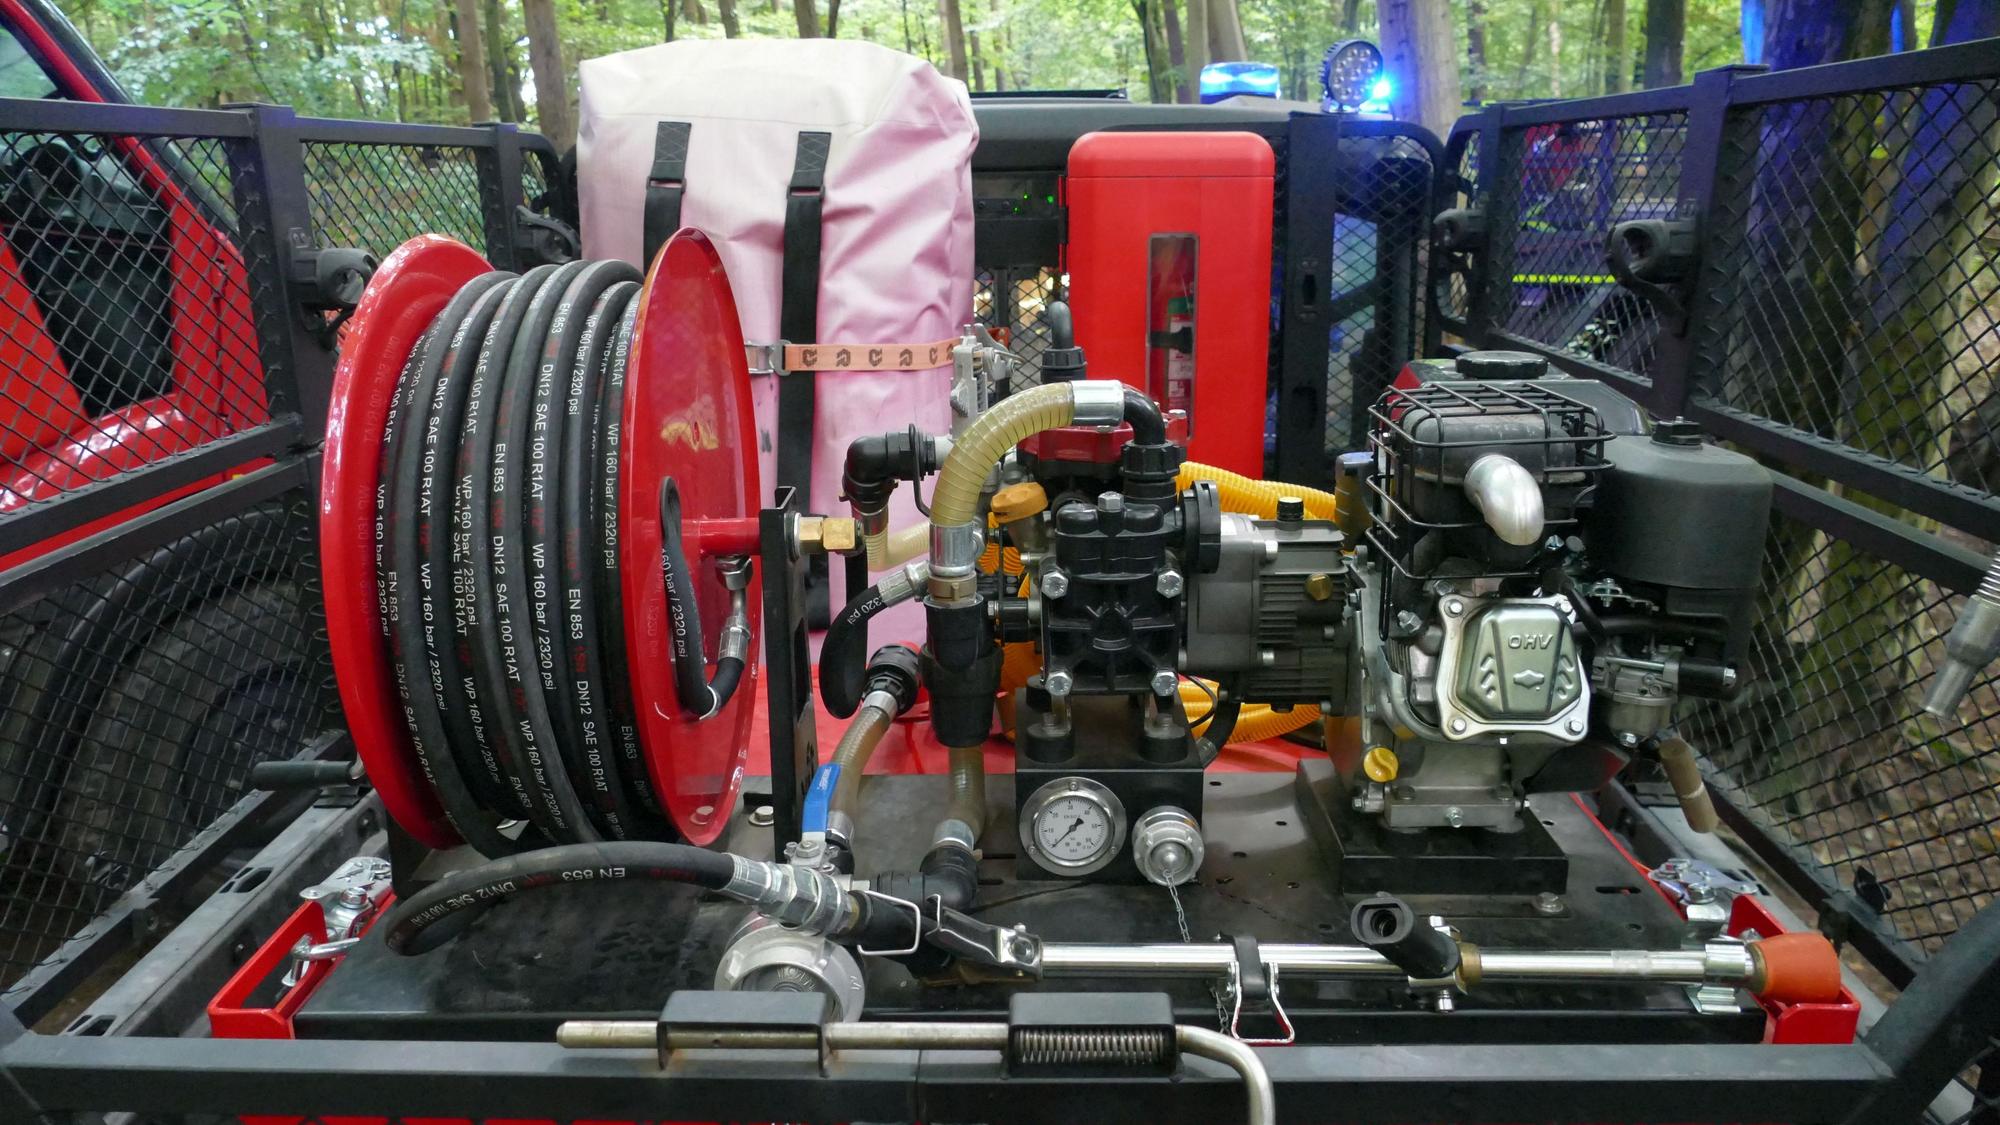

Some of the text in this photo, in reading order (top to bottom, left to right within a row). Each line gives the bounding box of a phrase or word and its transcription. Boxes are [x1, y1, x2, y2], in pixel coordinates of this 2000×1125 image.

[551, 303, 571, 334] EN 853
[618, 321, 633, 338] SAE
[451, 331, 466, 349] 853
[579, 329, 593, 345] 160
[616, 339, 629, 357] 100
[576, 345, 590, 361] bar
[466, 320, 500, 434] DN12 SAE 100 R1AT
[571, 369, 585, 396] 2320
[611, 359, 626, 387] R1AT
[391, 387, 402, 408] 100
[567, 398, 580, 415] psi
[383, 410, 397, 443] R1AT
[531, 364, 554, 501] DN12 SAE 100 R1AT
[608, 423, 619, 446] WP
[420, 377, 449, 517] DN12 SAE 100 R1AT
[493, 443, 506, 493] EN 853
[605, 450, 618, 474] 160
[377, 484, 386, 510] WP
[462, 474, 473, 500] WP
[605, 478, 617, 500] bar
[375, 514, 384, 540] 160
[461, 504, 472, 529] 160
[605, 512, 617, 546] 2320
[375, 544, 384, 567] bar
[453, 532, 461, 563] SAE
[461, 533, 472, 556] bar
[532, 543, 544, 569] WP
[604, 550, 617, 569] psi
[420, 562, 432, 590] WP
[453, 568, 464, 594] 100
[463, 568, 476, 602] 2320
[533, 573, 546, 598] 160
[664, 572, 676, 594] bar
[377, 580, 388, 614] 2320
[388, 571, 398, 622] EN 853
[423, 595, 433, 621] 160
[493, 535, 521, 682] DN12 SAE 100 R1AT
[860, 596, 882, 615] 320
[455, 597, 468, 637] R1AT
[466, 606, 479, 625] psi
[535, 602, 547, 625] bar
[568, 588, 583, 640] EN 853
[671, 604, 686, 636] 2320
[425, 625, 435, 648] bar
[675, 639, 688, 657] psi
[1508, 634, 1554, 650] OHV
[538, 636, 553, 669] 2320
[429, 660, 444, 691] 2320
[463, 677, 476, 700] WP
[541, 671, 557, 690] psi
[395, 663, 410, 700] DN12
[404, 705, 418, 732] SAE
[469, 703, 482, 724] 160
[576, 680, 608, 793] DN12 SAE 100 R1AT
[621, 725, 638, 760] EN 853
[519, 720, 534, 742] WP
[527, 745, 541, 766] 160
[534, 767, 546, 786] bar
[508, 776, 522, 791] EN
[562, 867, 625, 882] EN 853
[447, 893, 476, 910] SAE
[476, 881, 517, 900] DN12
